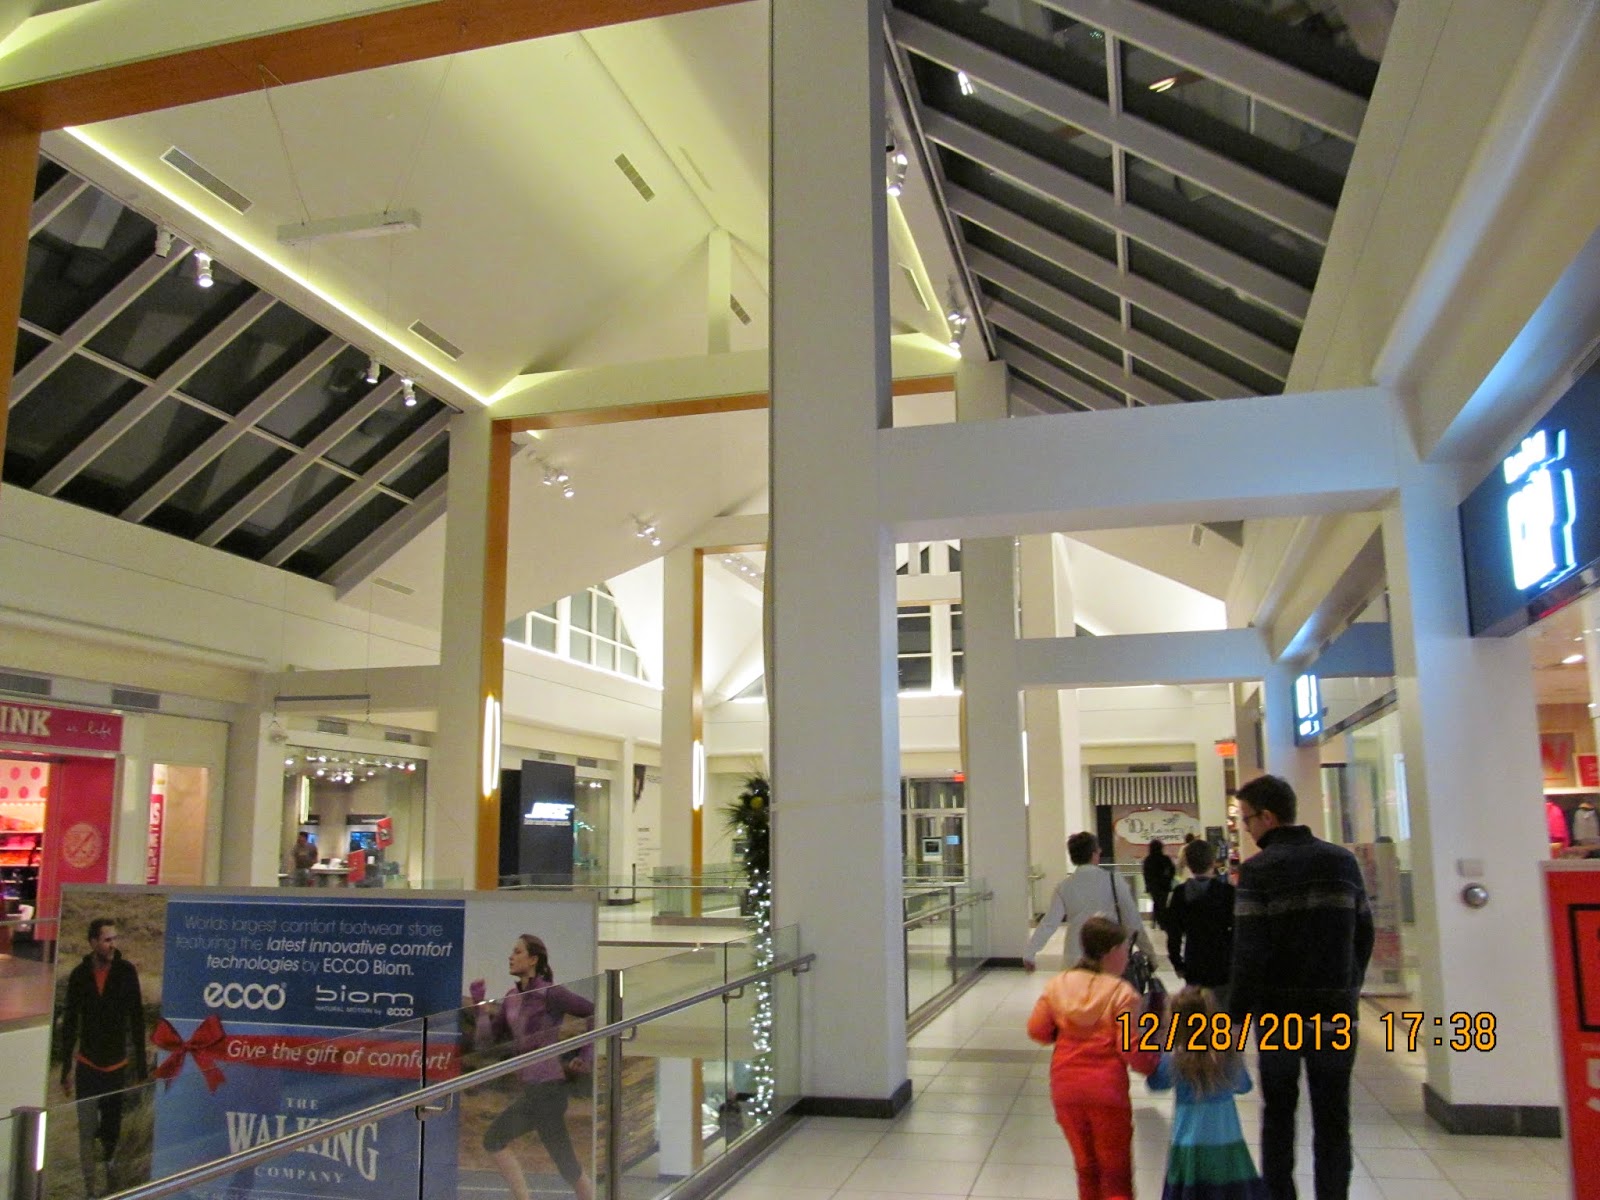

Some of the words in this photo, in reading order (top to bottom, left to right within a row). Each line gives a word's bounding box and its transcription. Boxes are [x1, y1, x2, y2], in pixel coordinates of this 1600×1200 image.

[184, 915, 229, 930] Worlds
[231, 916, 277, 934] largest
[281, 919, 336, 934] comfort
[340, 919, 404, 935] footwear
[408, 922, 444, 937] store
[175, 934, 237, 954] featuring
[240, 936, 264, 951] the
[267, 936, 308, 952] latest
[309, 938, 387, 955] innovative
[390, 941, 454, 957] comfort
[207, 954, 300, 974] technologies
[302, 958, 320, 975] by
[323, 957, 370, 974] ECCO
[373, 959, 415, 976] Biom.
[203, 981, 286, 1011] ecco
[315, 984, 414, 1005] biom
[386, 1007, 414, 1017] ecco
[227, 1039, 267, 1059] Give
[272, 1042, 302, 1062] the
[306, 1043, 339, 1070] gift
[342, 1046, 365, 1065] of
[368, 1049, 452, 1071] comfort!
[286, 1098, 319, 1110] THE
[254, 1166, 345, 1184] COMPANY
